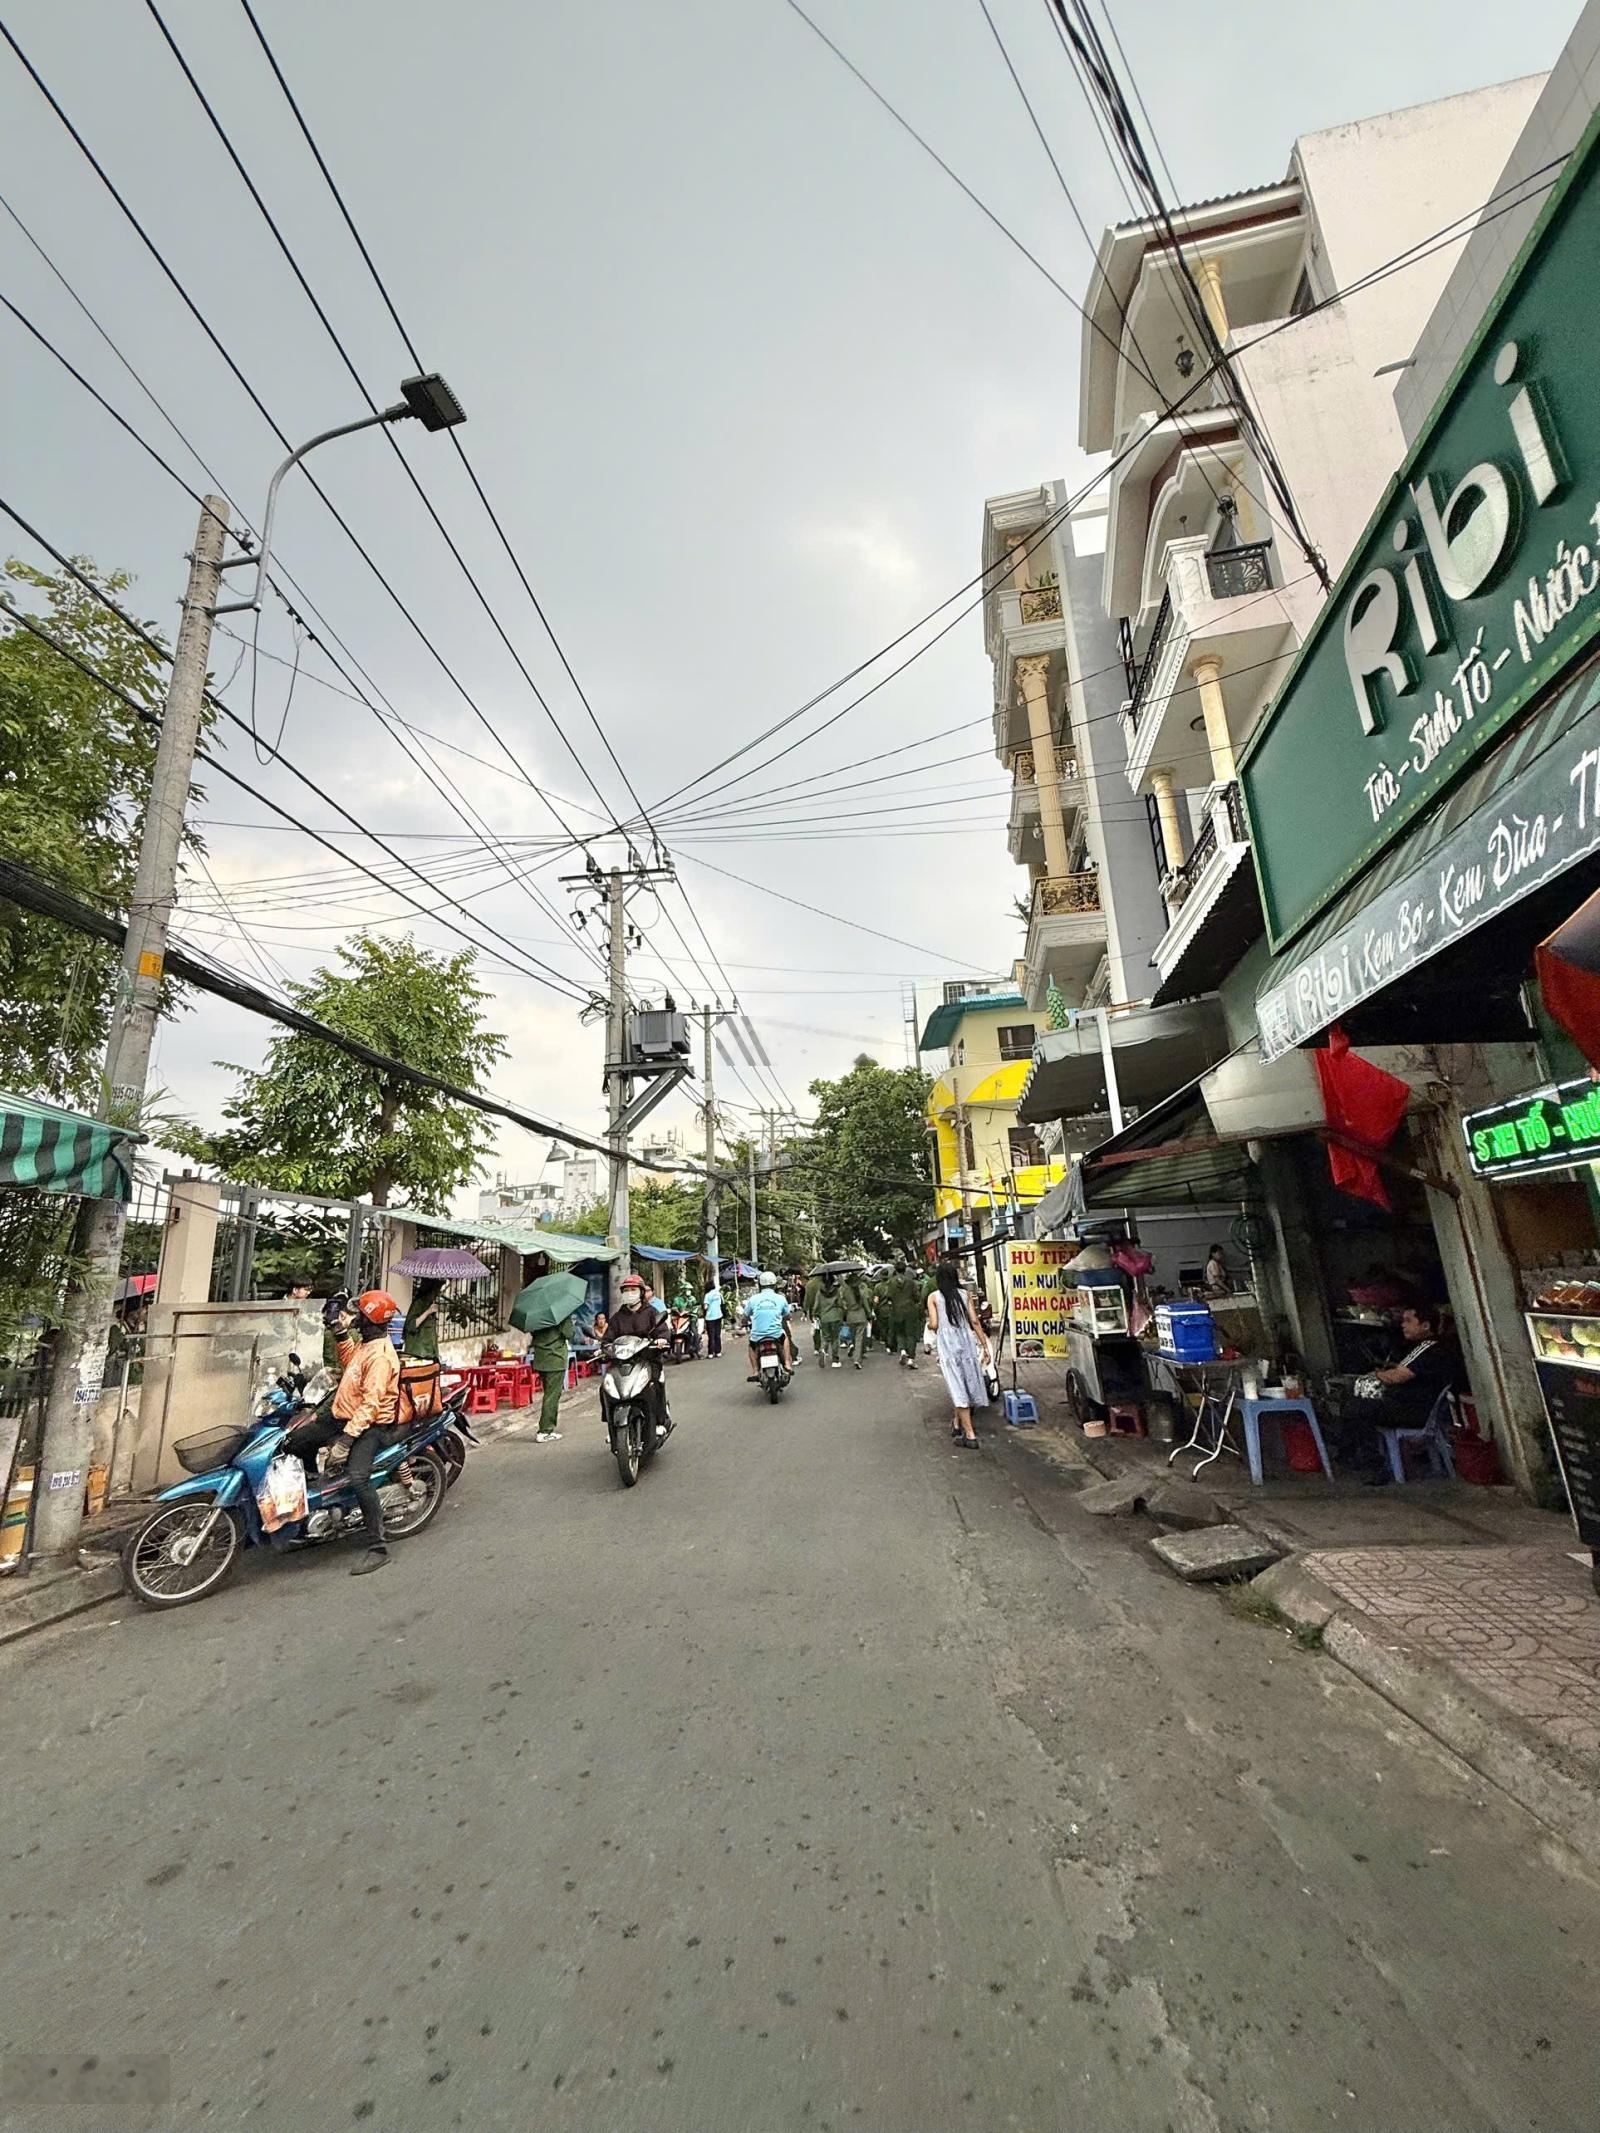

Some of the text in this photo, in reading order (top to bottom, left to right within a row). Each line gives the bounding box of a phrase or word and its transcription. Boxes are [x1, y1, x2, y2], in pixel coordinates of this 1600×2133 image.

[1344, 341, 1558, 736] Ribi
[1409, 690, 1462, 773] Sinh
[1451, 626, 1491, 720] Tố
[1514, 540, 1600, 663] Nước
[1296, 945, 1351, 1031] Ribi
[1364, 928, 1396, 982] Kem
[1439, 864, 1486, 928] Kem
[1011, 1245, 1035, 1265] HỦ
[1012, 1271, 1026, 1288] MÌ
[1037, 1275, 1057, 1288] NUI
[1014, 1292, 1047, 1311] BÁNH
[1016, 1316, 1039, 1335] BÚN
